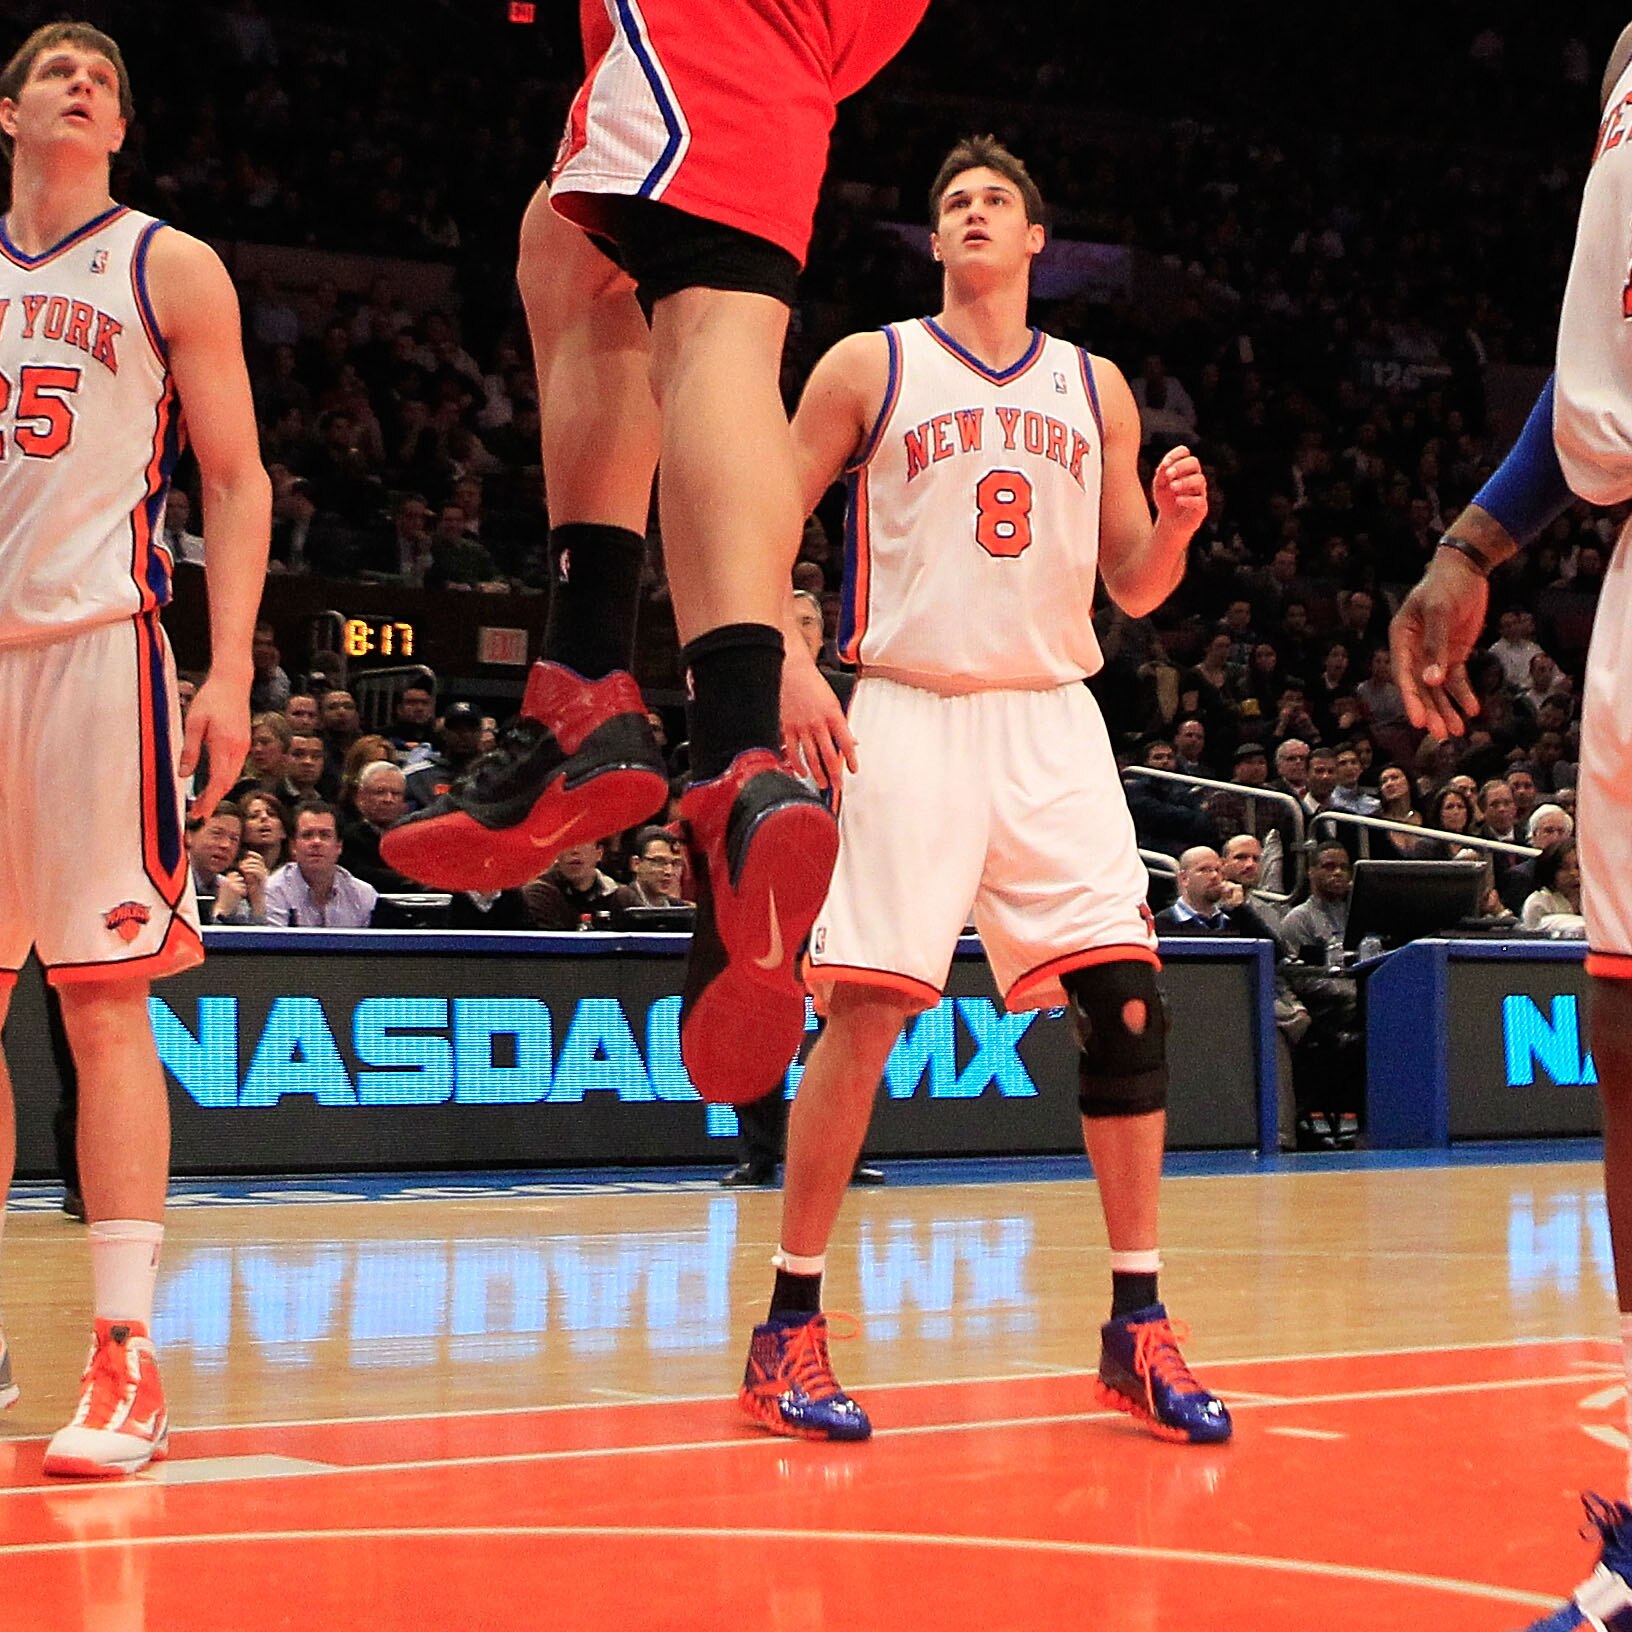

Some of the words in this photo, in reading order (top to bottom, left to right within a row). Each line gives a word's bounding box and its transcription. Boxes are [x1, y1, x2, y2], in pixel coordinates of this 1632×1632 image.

[22, 294, 124, 376] YORK
[903, 408, 984, 484] NEW
[995, 406, 1091, 493] YORK
[975, 469, 1033, 558] 8
[342, 618, 414, 657] 8:17
